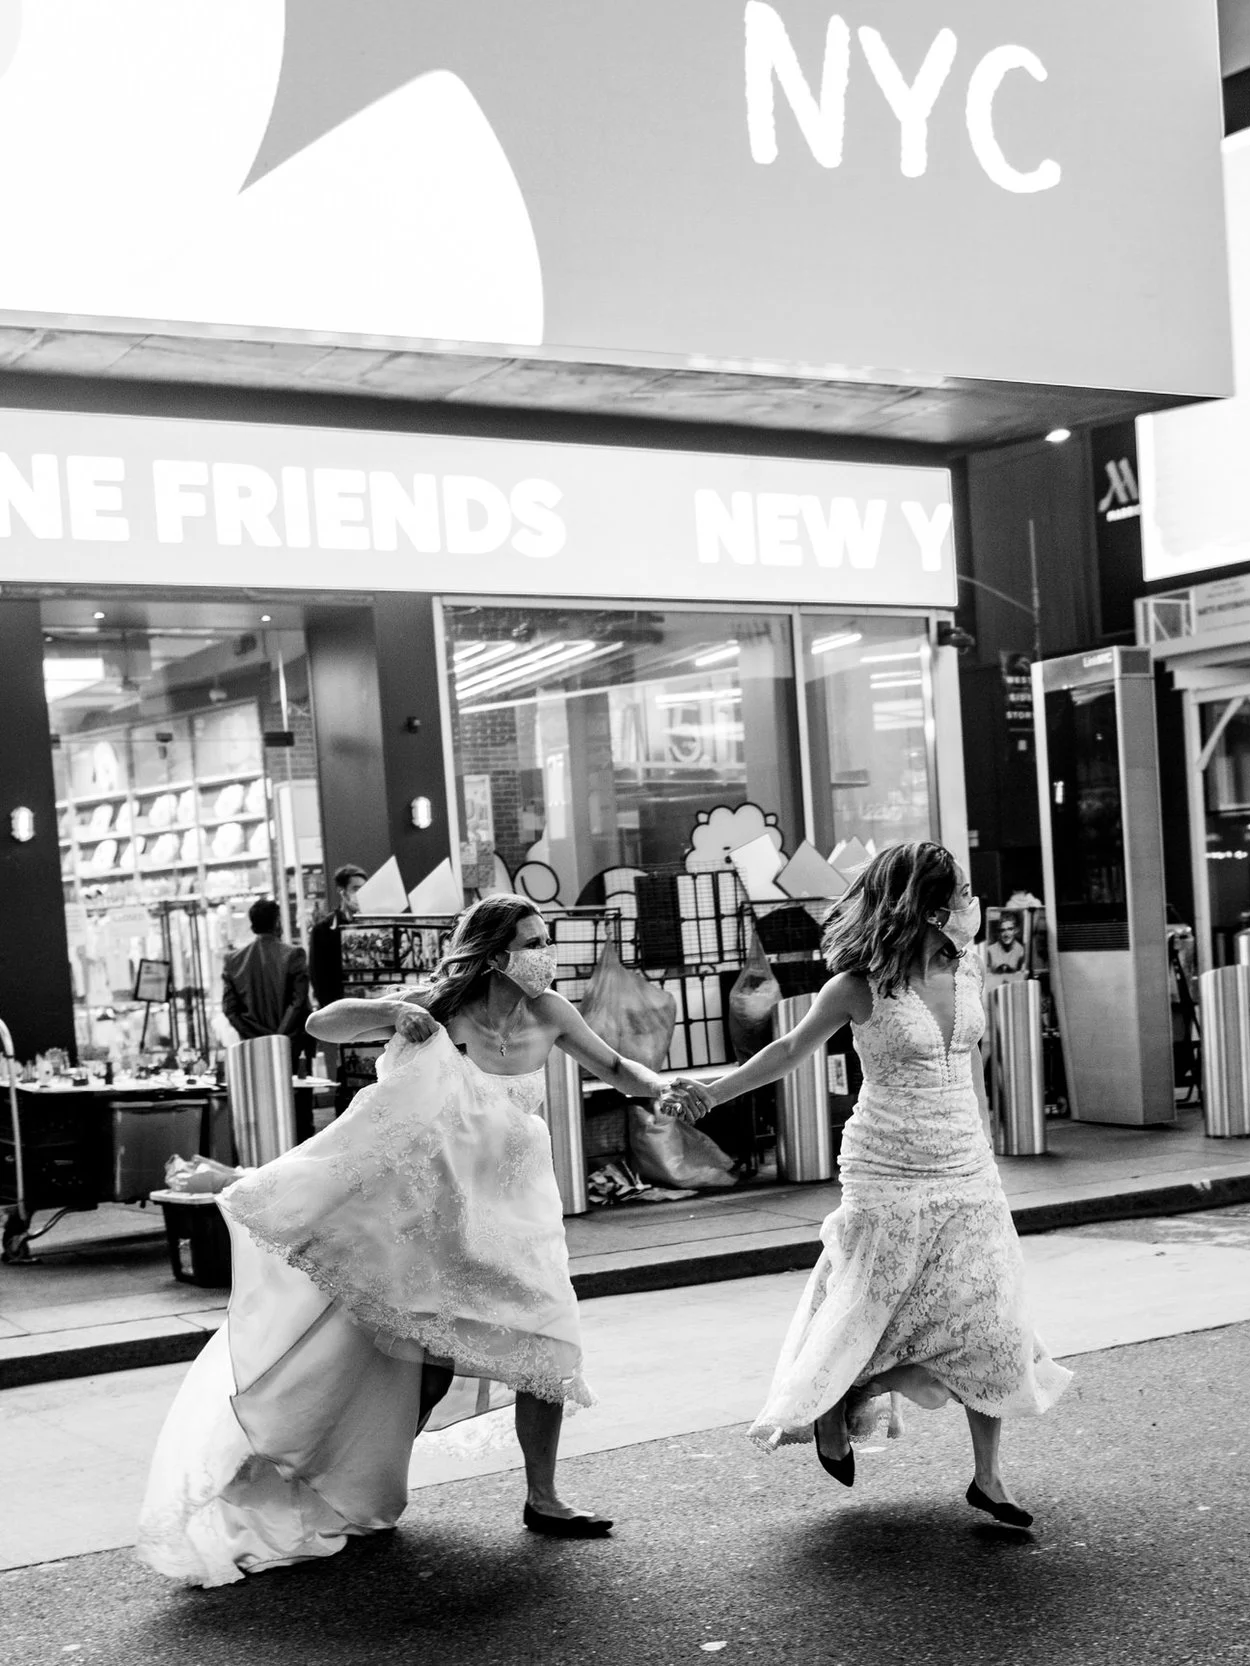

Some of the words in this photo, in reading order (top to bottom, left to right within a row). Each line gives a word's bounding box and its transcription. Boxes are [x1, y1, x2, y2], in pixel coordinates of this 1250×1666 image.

[744, 0, 1062, 194] NYC
[152, 458, 567, 559] FRIENDS
[694, 489, 887, 568] NEW
[901, 502, 952, 573] Y
